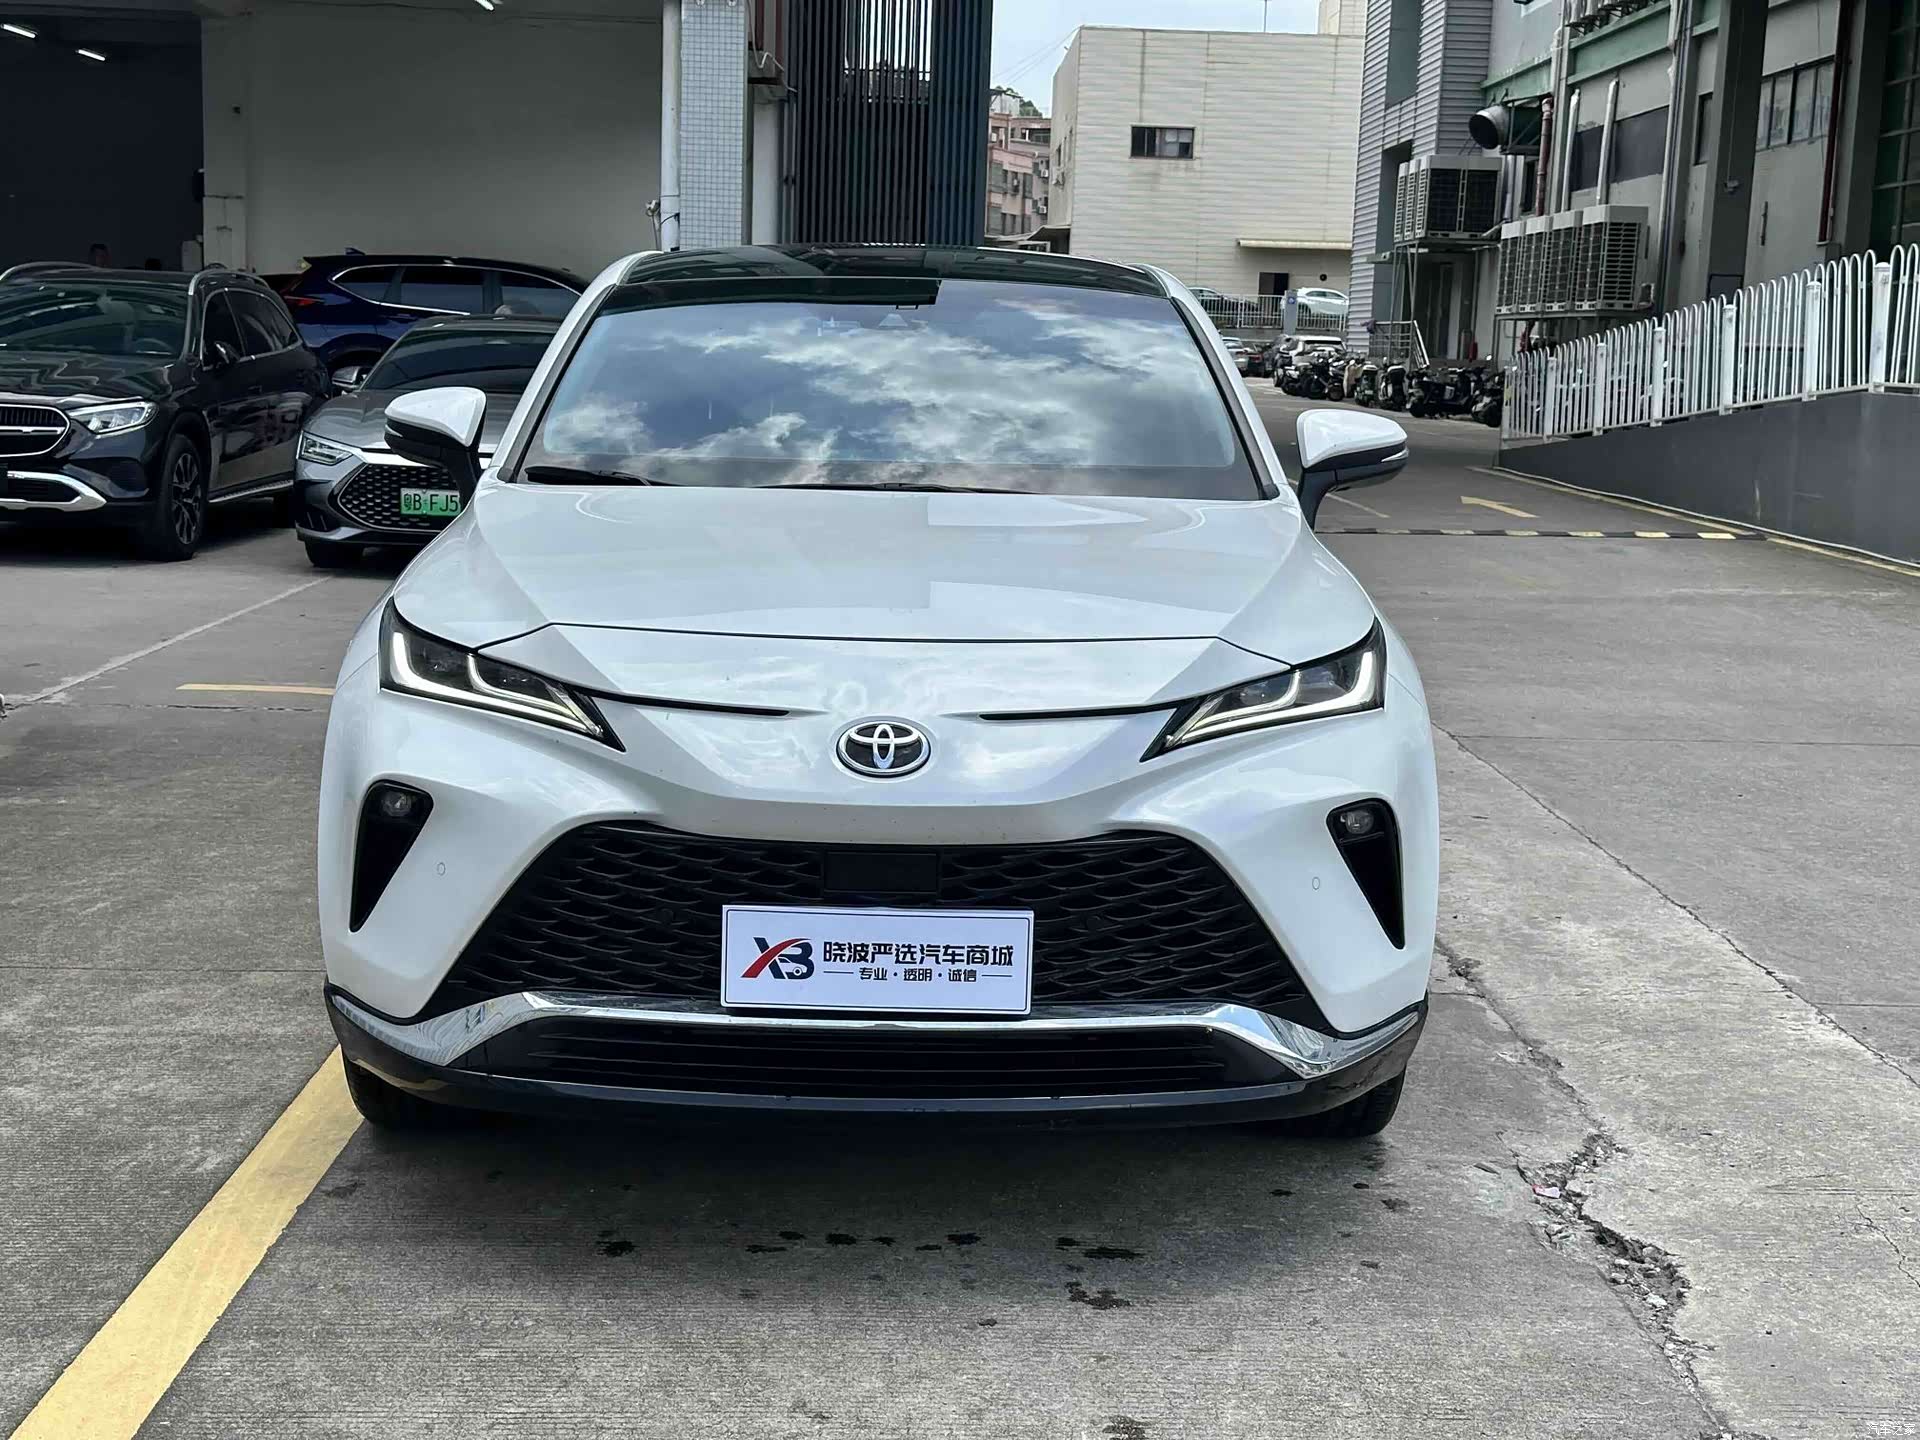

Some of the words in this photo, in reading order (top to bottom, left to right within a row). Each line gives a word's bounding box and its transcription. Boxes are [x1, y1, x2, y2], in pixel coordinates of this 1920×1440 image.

[823, 941, 1013, 967] 晓波严选汽车商城
